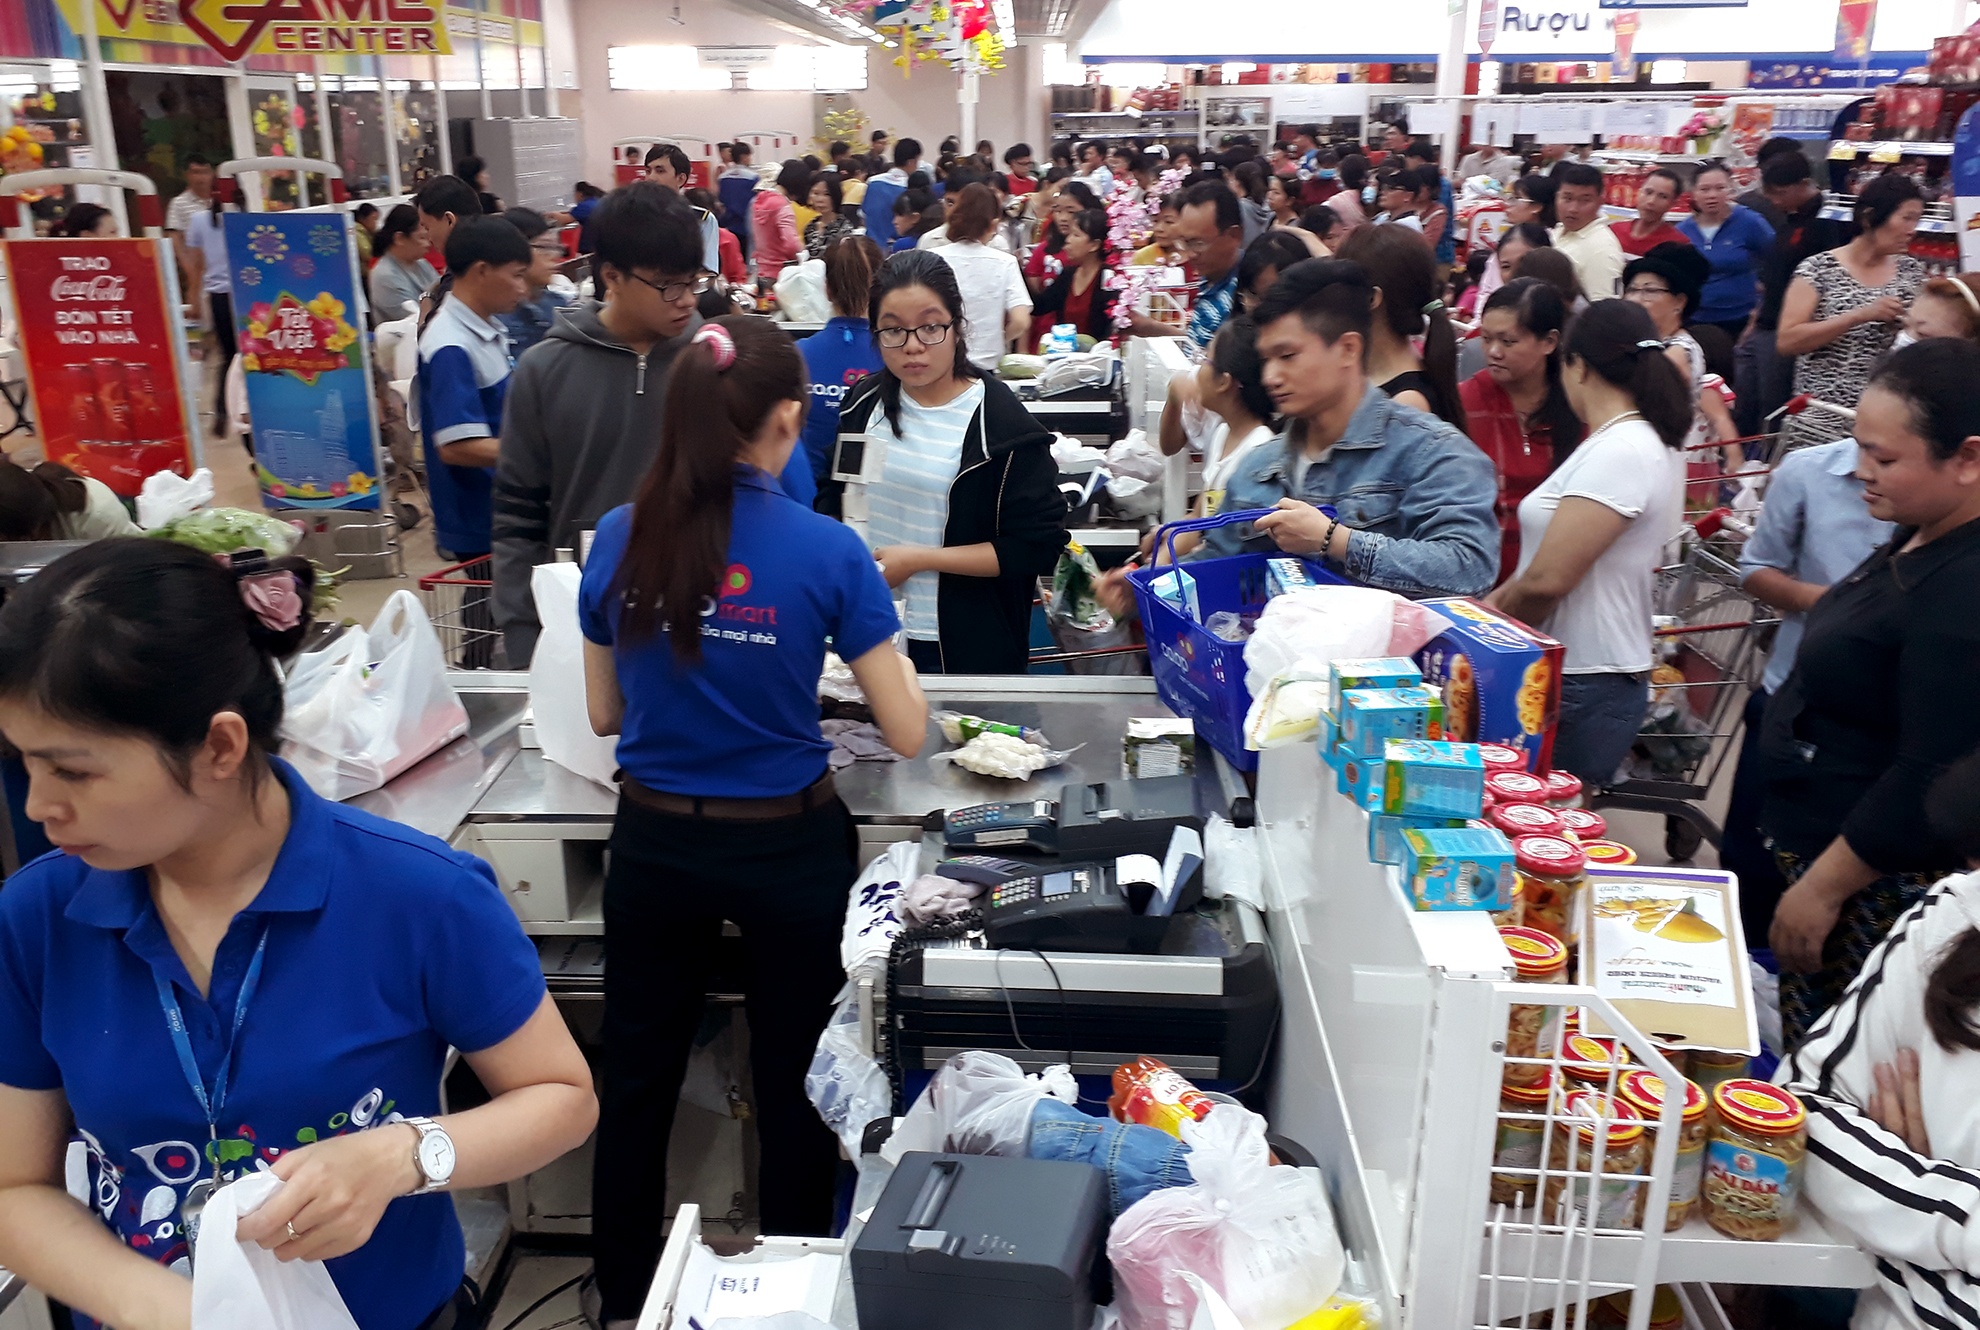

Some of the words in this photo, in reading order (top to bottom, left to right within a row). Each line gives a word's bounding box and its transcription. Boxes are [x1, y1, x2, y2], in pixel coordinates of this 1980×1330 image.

[1502, 7, 1590, 38] Rượu
[275, 27, 440, 51] CENTER
[58, 257, 111, 270] TRAO
[278, 306, 313, 329] Tết
[267, 329, 317, 354] Việt
[721, 630, 748, 644] mọi
[749, 632, 777, 645] nhà
